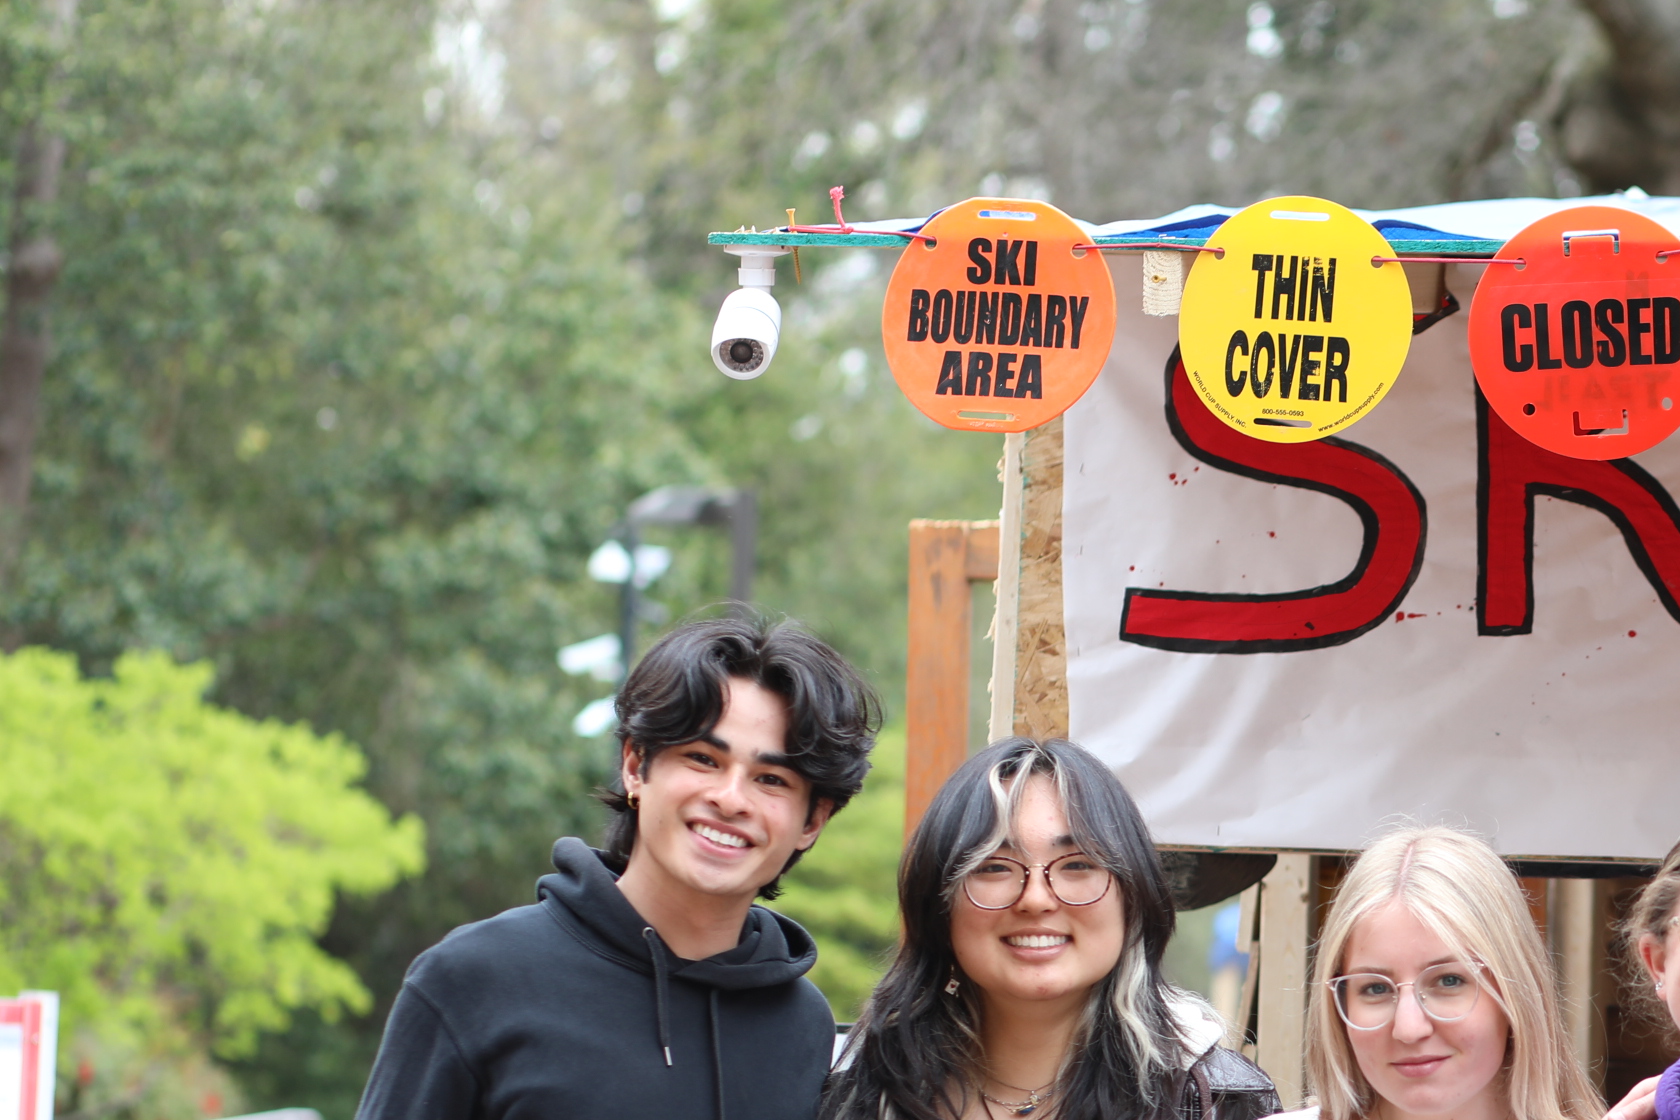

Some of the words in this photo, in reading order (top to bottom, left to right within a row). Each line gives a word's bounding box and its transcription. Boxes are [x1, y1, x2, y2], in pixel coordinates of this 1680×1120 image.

[967, 238, 1038, 286] SKI
[1252, 253, 1337, 323] THIN
[907, 289, 1090, 349] BOUNDARY
[935, 350, 1043, 399] AREA
[1224, 329, 1350, 403] COVER
[1193, 370, 1206, 393] WORLD
[1205, 393, 1216, 404] CUP
[1235, 418, 1247, 429] INC.
[1261, 408, 1304, 417] 800-555-0593
[1318, 382, 1385, 433] www.worldcupsupply.com
